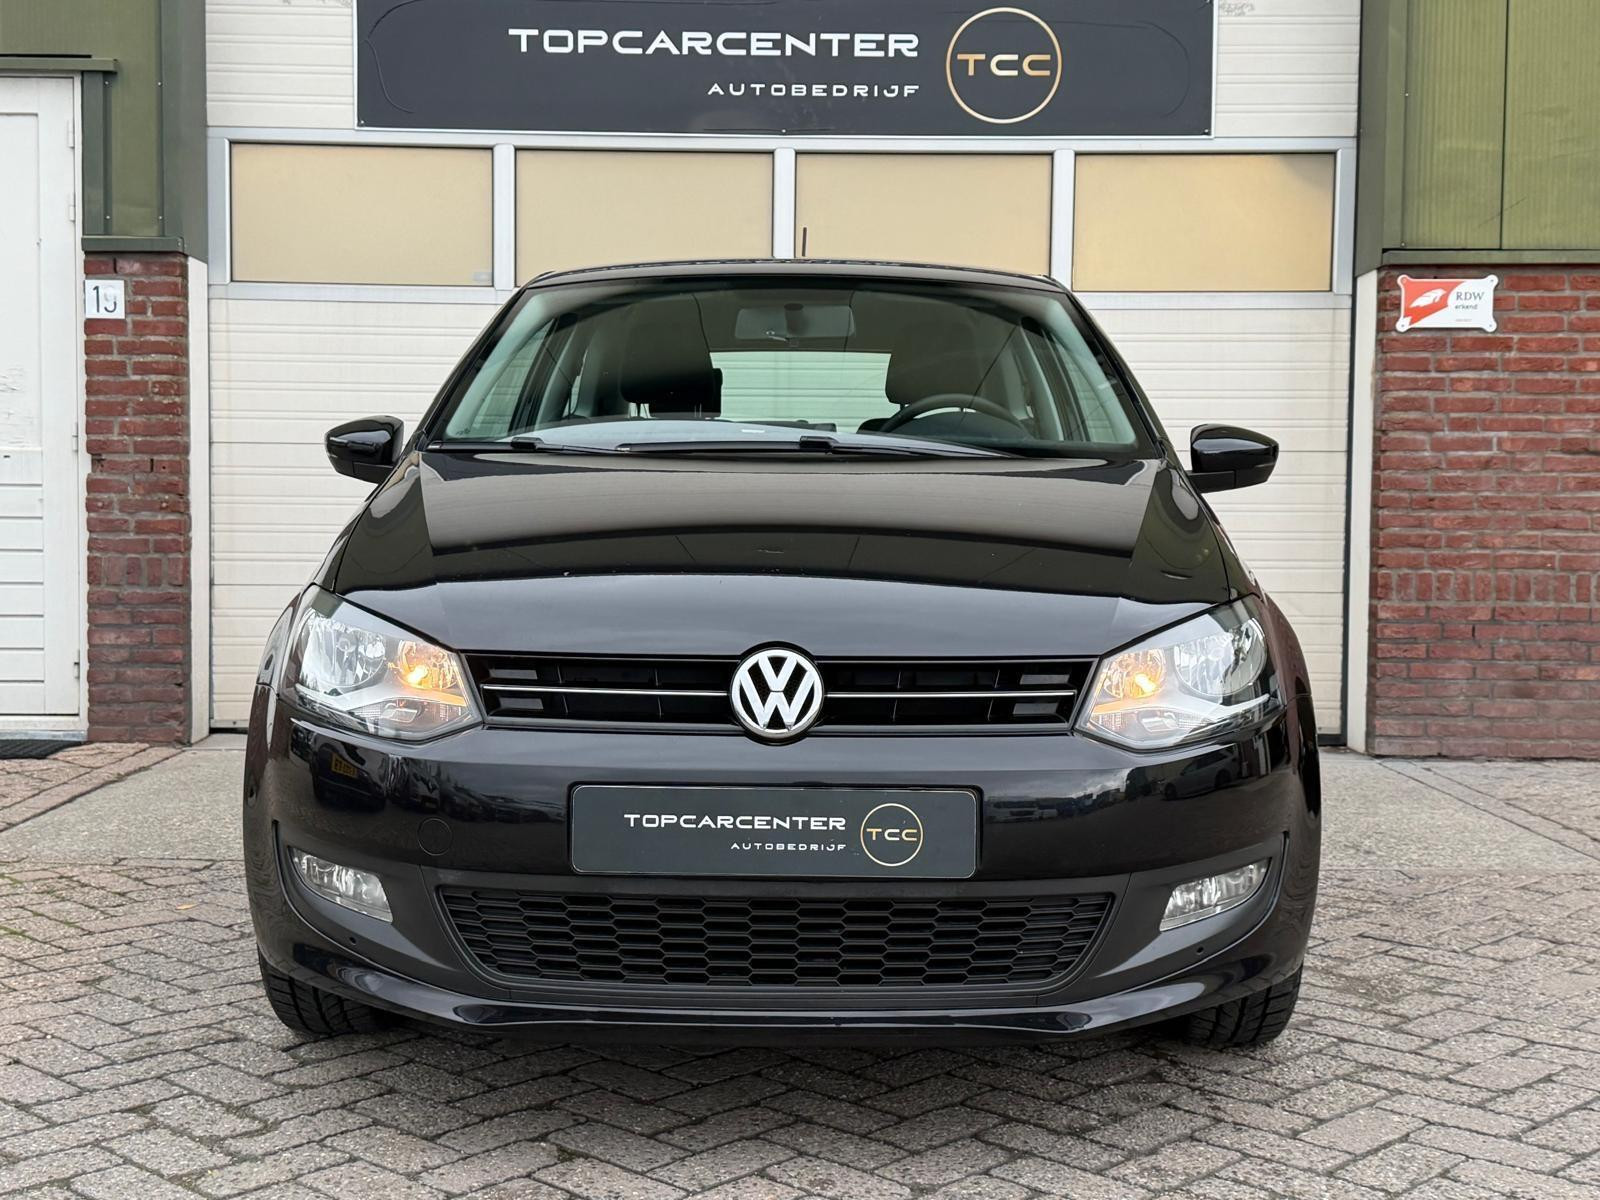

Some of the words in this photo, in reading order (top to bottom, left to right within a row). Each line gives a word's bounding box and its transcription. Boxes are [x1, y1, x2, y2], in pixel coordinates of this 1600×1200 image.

[508, 28, 919, 57] TOPCARCENTER
[957, 53, 1051, 76] TCC
[707, 82, 920, 98] AUTOBEDRIJF
[1456, 291, 1485, 301] RDW
[623, 813, 847, 831] TOPCARCENTER
[866, 828, 918, 842] TCC
[730, 841, 848, 852] AUTOBEDRIJF
